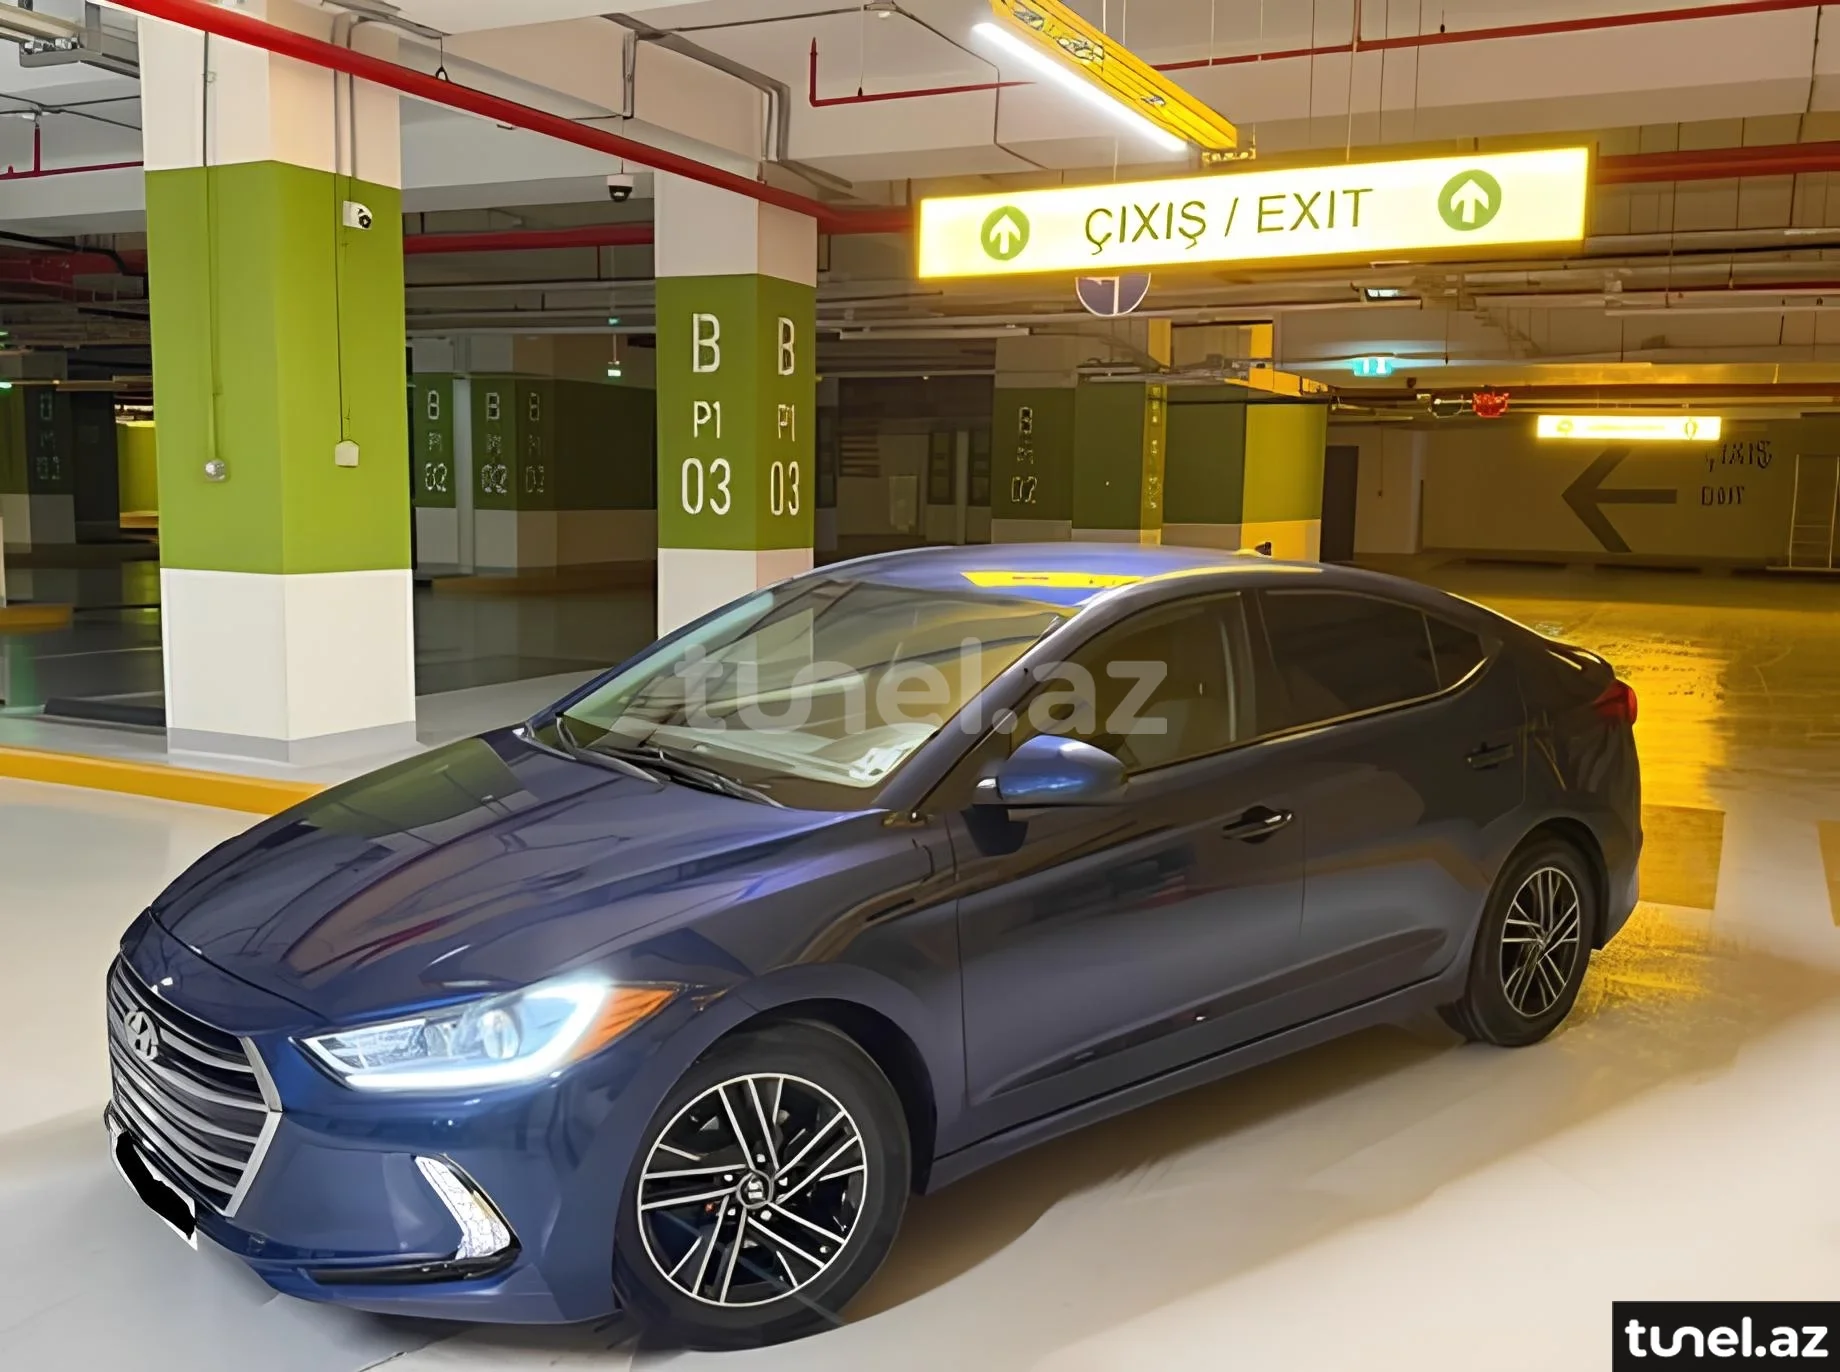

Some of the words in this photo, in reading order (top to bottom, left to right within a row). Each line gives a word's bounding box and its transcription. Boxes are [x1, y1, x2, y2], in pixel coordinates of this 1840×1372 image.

[1085, 200, 1207, 256] ÇIXIŞ
[1224, 197, 1239, 237] /
[1258, 188, 1374, 234] EXIT
[692, 312, 721, 373] B
[777, 316, 795, 376] B
[693, 400, 721, 439] P1
[681, 457, 731, 515] 03
[770, 460, 800, 516] 03
